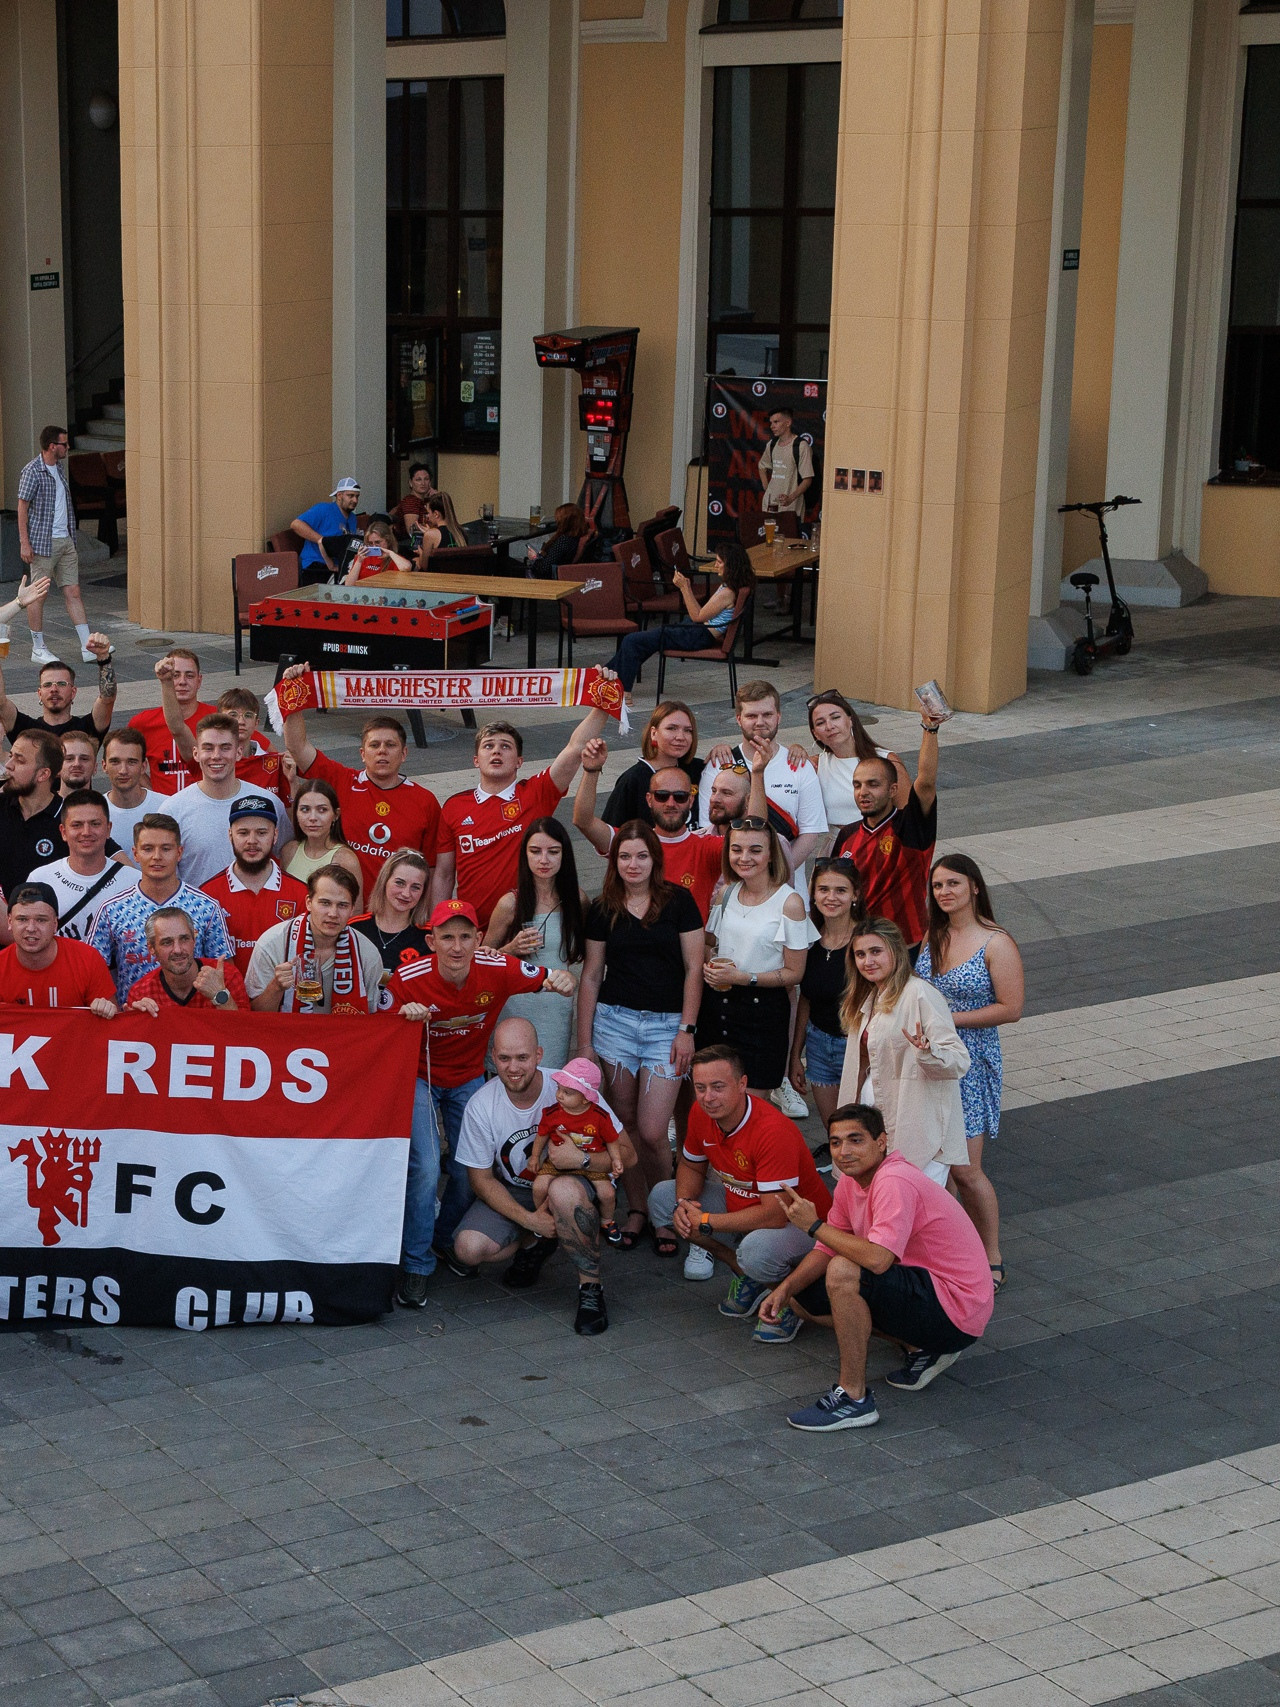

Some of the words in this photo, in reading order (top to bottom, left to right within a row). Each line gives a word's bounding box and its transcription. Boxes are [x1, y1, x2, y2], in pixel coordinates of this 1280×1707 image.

[729, 410, 770, 440] WE
[345, 677, 472, 698] MANCHESTER
[481, 676, 553, 697] UNITED
[347, 840, 394, 859] vodafo
[61, 877, 84, 892] UNITED
[333, 926, 353, 995] NITED
[106, 1040, 330, 1104] REDS
[508, 1130, 530, 1144] UNITED
[175, 1286, 314, 1331] CLUB
